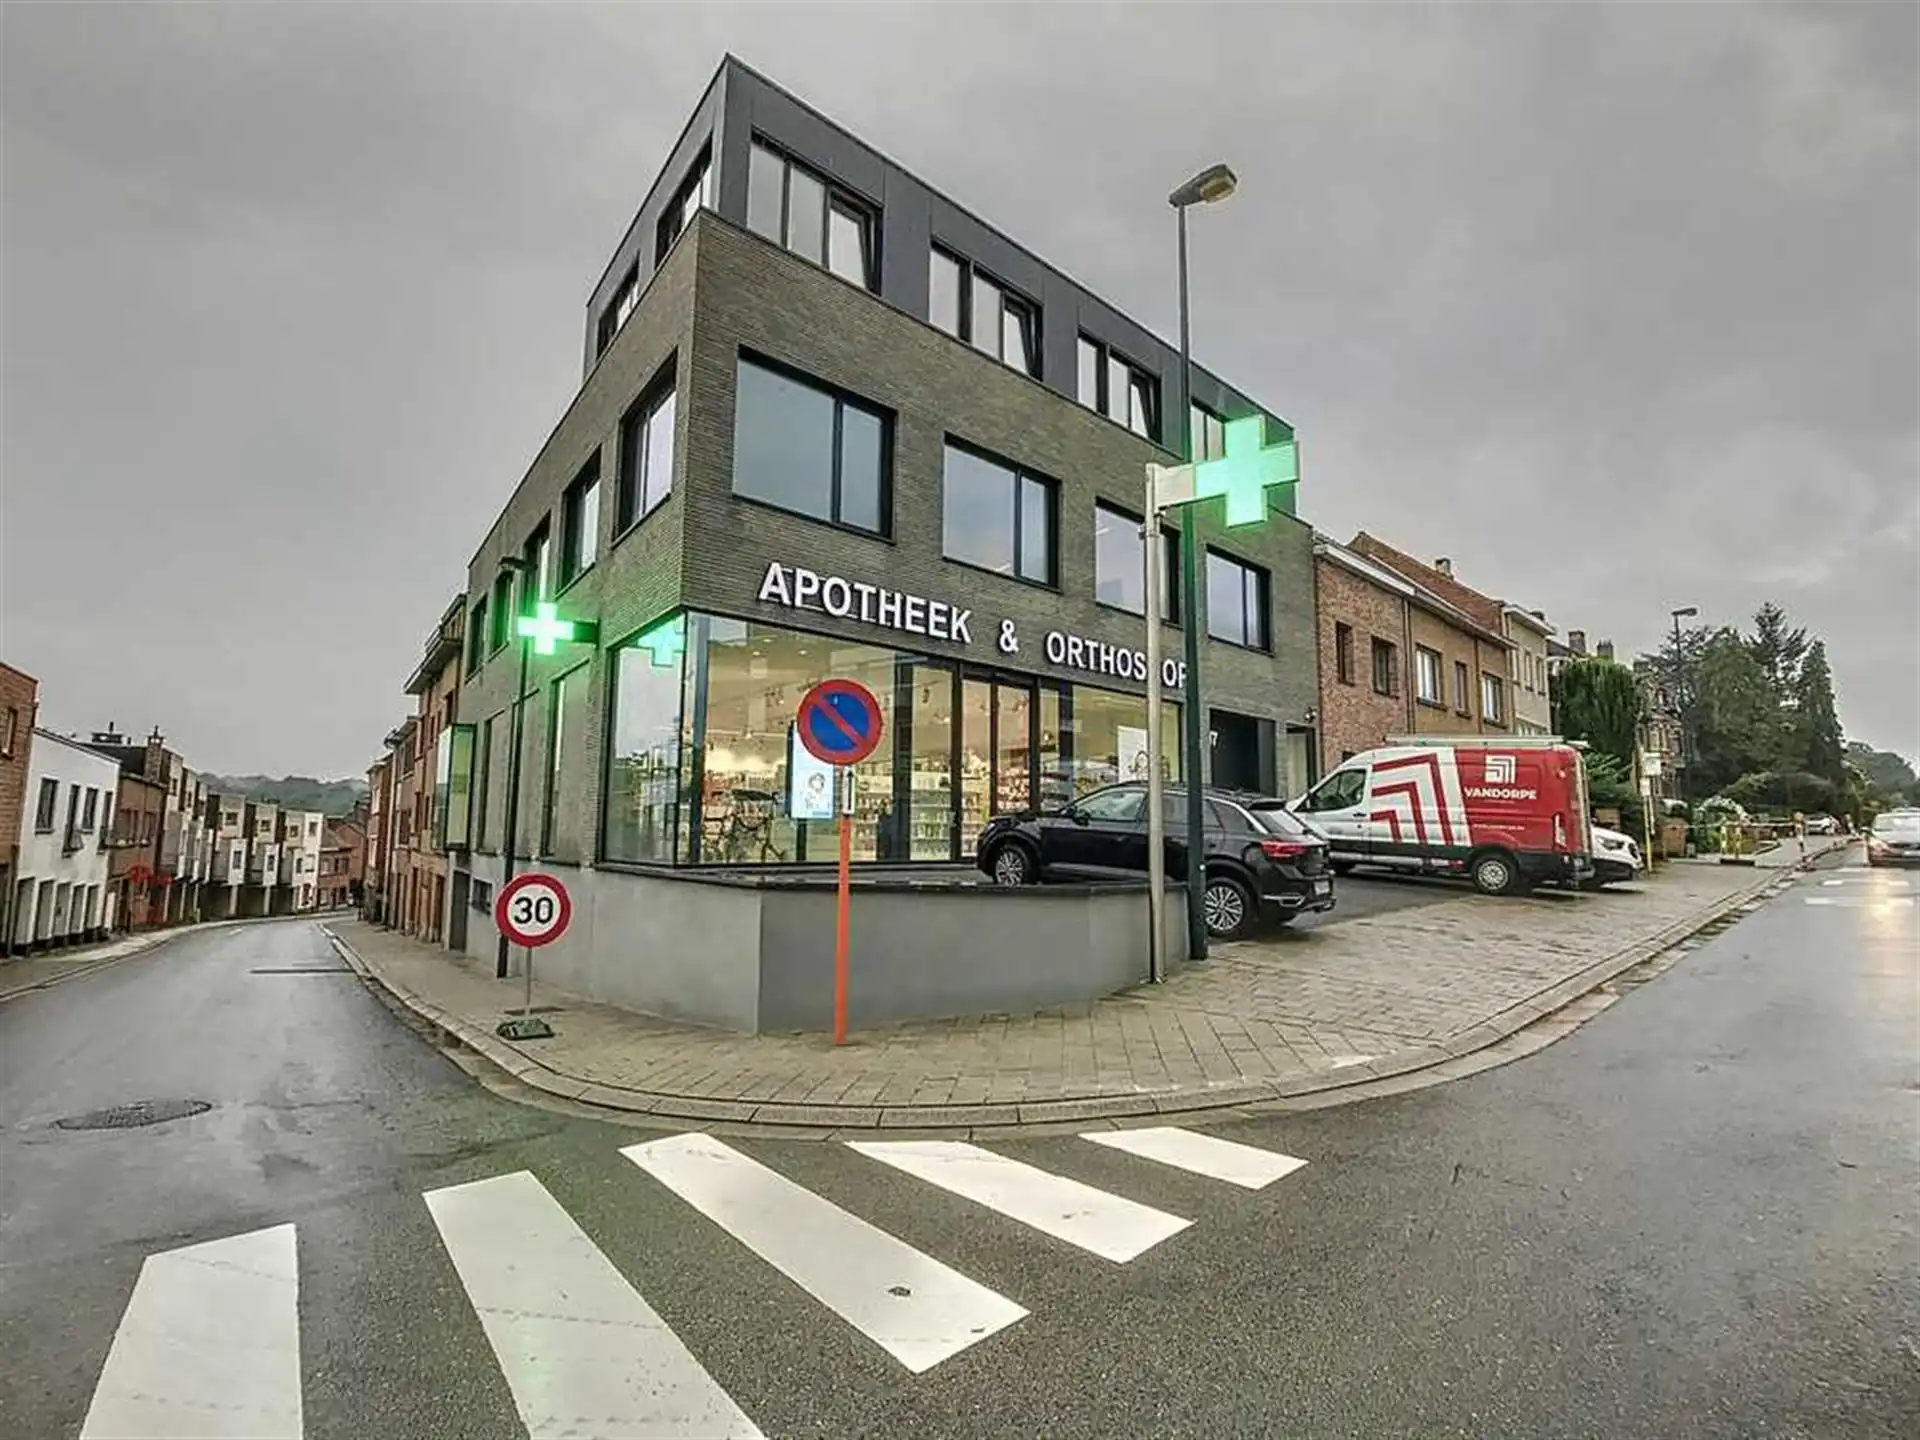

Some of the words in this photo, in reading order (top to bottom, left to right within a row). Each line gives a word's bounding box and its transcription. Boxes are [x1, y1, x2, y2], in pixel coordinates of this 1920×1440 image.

[758, 562, 972, 643] APOTHEEK
[1000, 619, 1019, 653] &
[1046, 631, 1187, 688] ORTHOSOP
[1464, 787, 1537, 799] VANDORPE
[514, 896, 554, 925] 30
